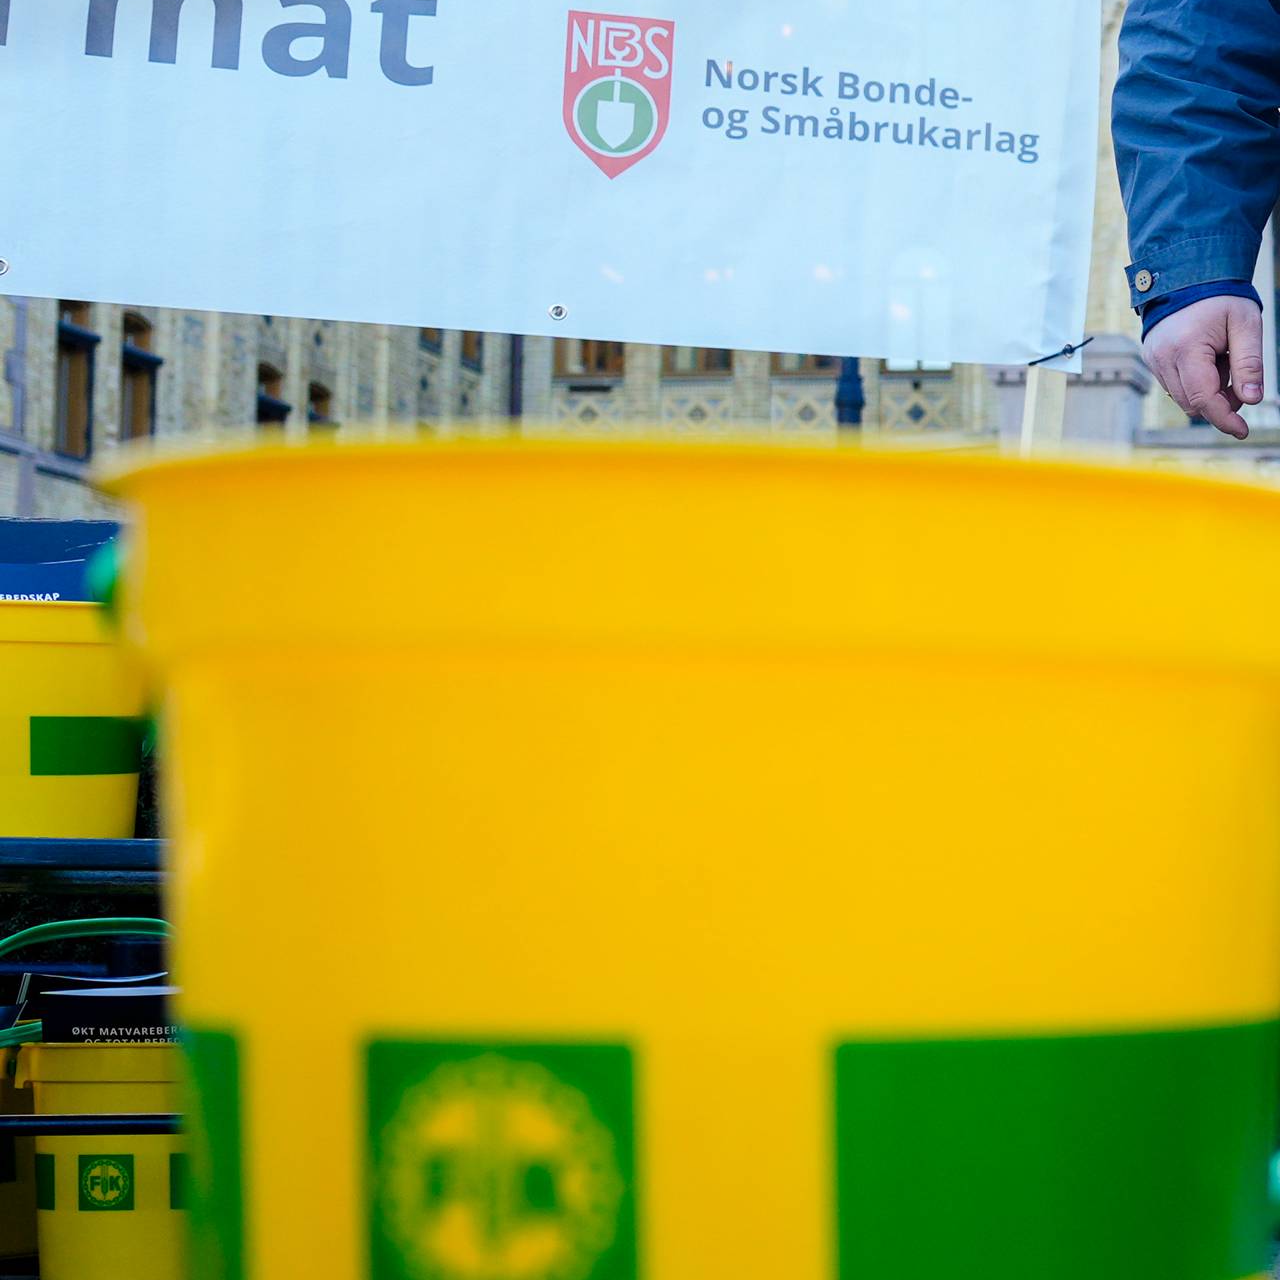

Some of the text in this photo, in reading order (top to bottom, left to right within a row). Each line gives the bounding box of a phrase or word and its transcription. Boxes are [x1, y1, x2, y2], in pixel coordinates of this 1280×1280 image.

[704, 58, 973, 109] Norsk Bonde-
[701, 105, 1040, 164] og Småbrukarlag
